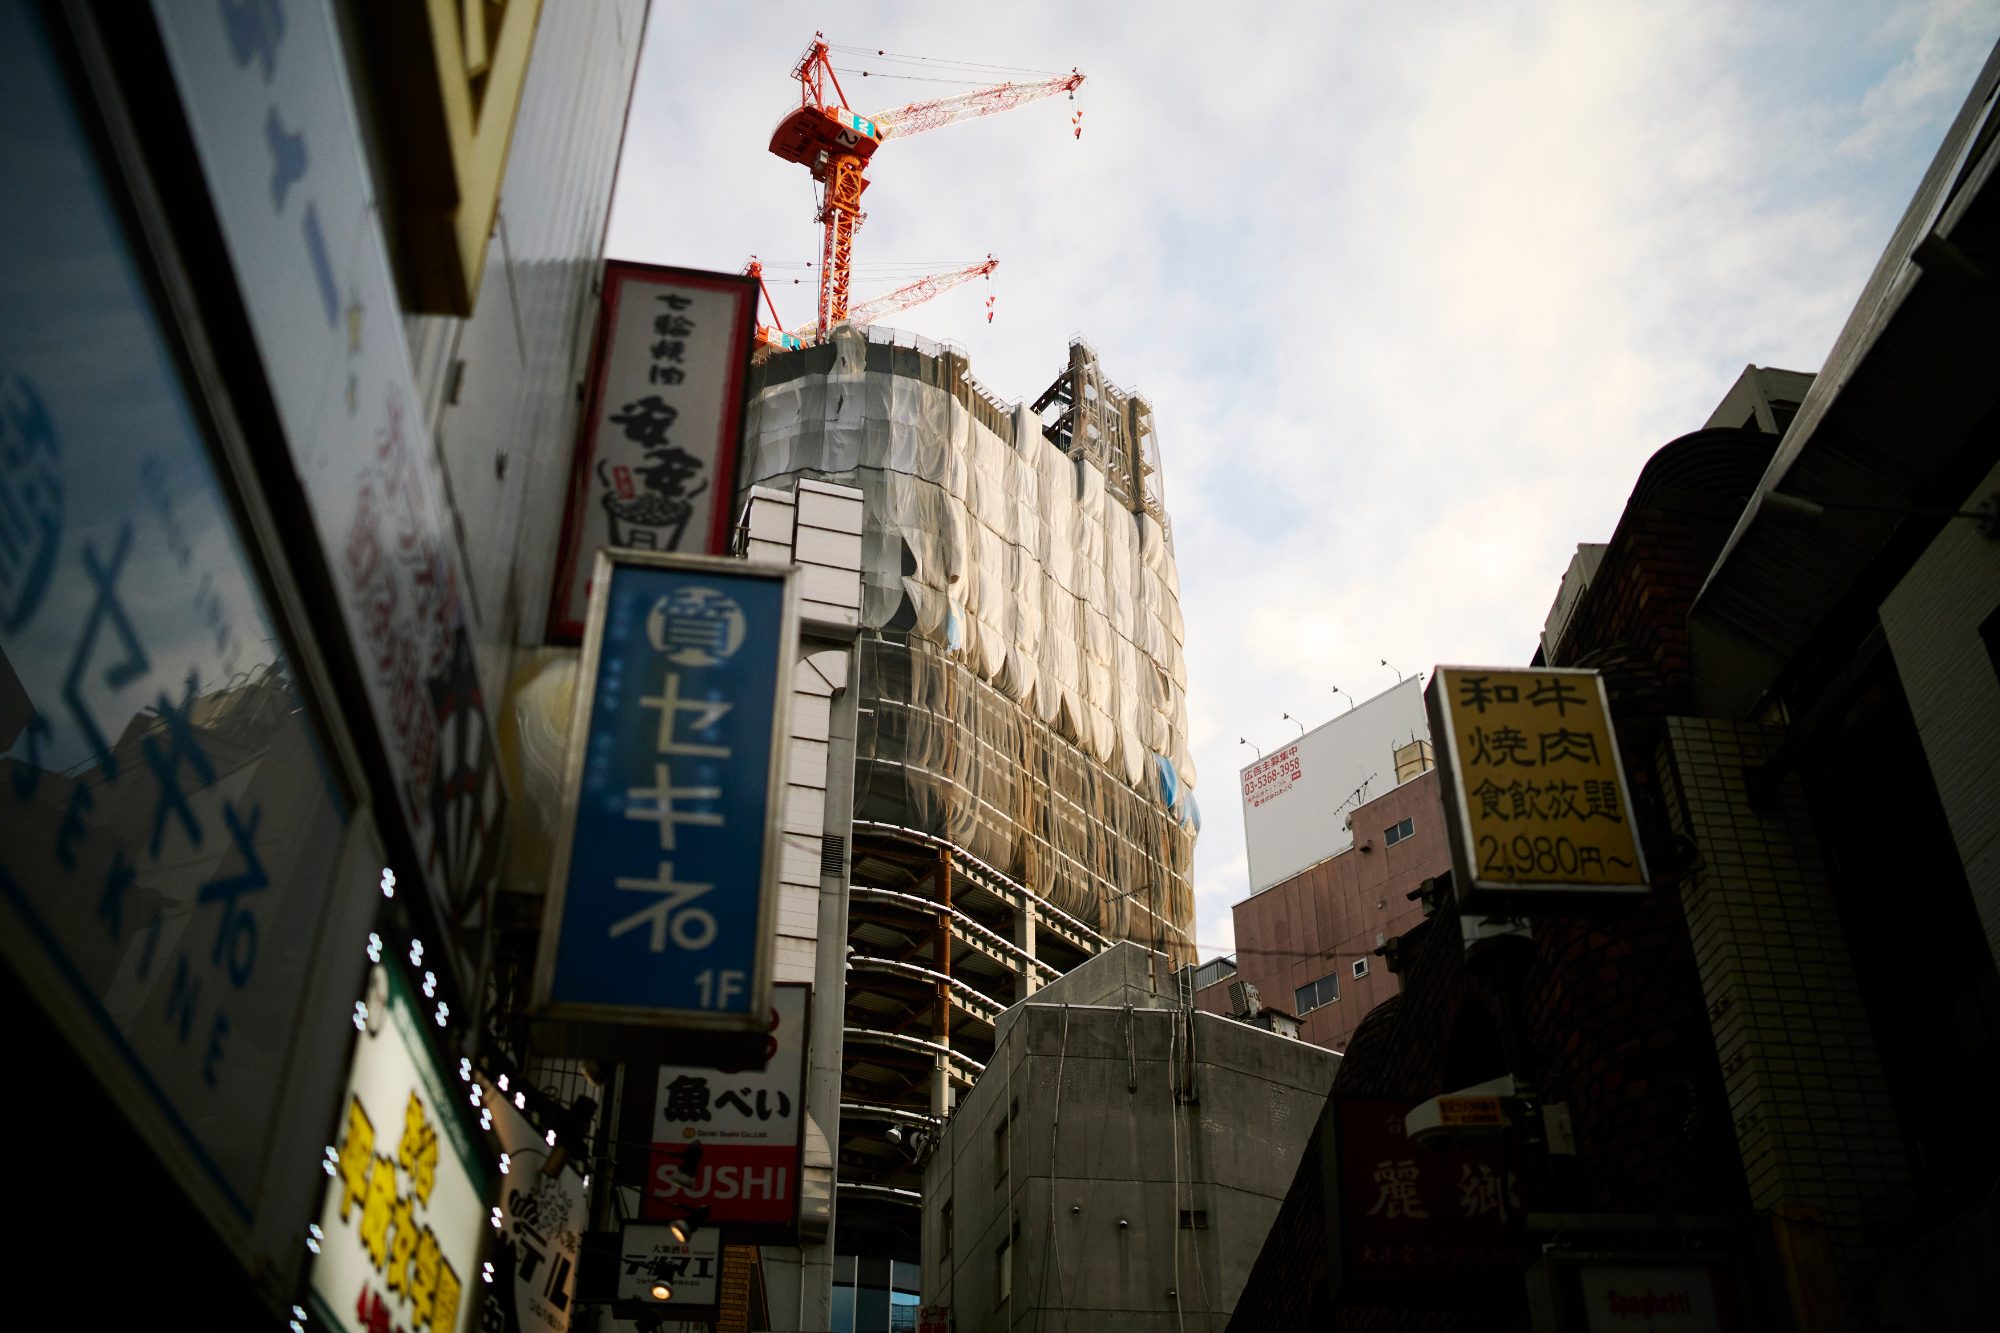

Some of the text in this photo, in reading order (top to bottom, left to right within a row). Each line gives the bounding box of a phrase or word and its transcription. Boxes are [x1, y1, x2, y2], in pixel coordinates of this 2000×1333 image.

[1460, 676, 1587, 718] 和牛
[1244, 746, 1298, 782] 広告主募集中
[1468, 726, 1600, 767] 焼肉
[1245, 757, 1300, 796] 03-5368-3958
[608, 672, 734, 954] セキネ
[1472, 778, 1622, 824] 食飲放題
[694, 968, 746, 1010] 1F
[664, 1075, 791, 1122] 魚べい
[652, 1163, 788, 1201] SUSHI
[1608, 1288, 1692, 1318] Spaghetti
